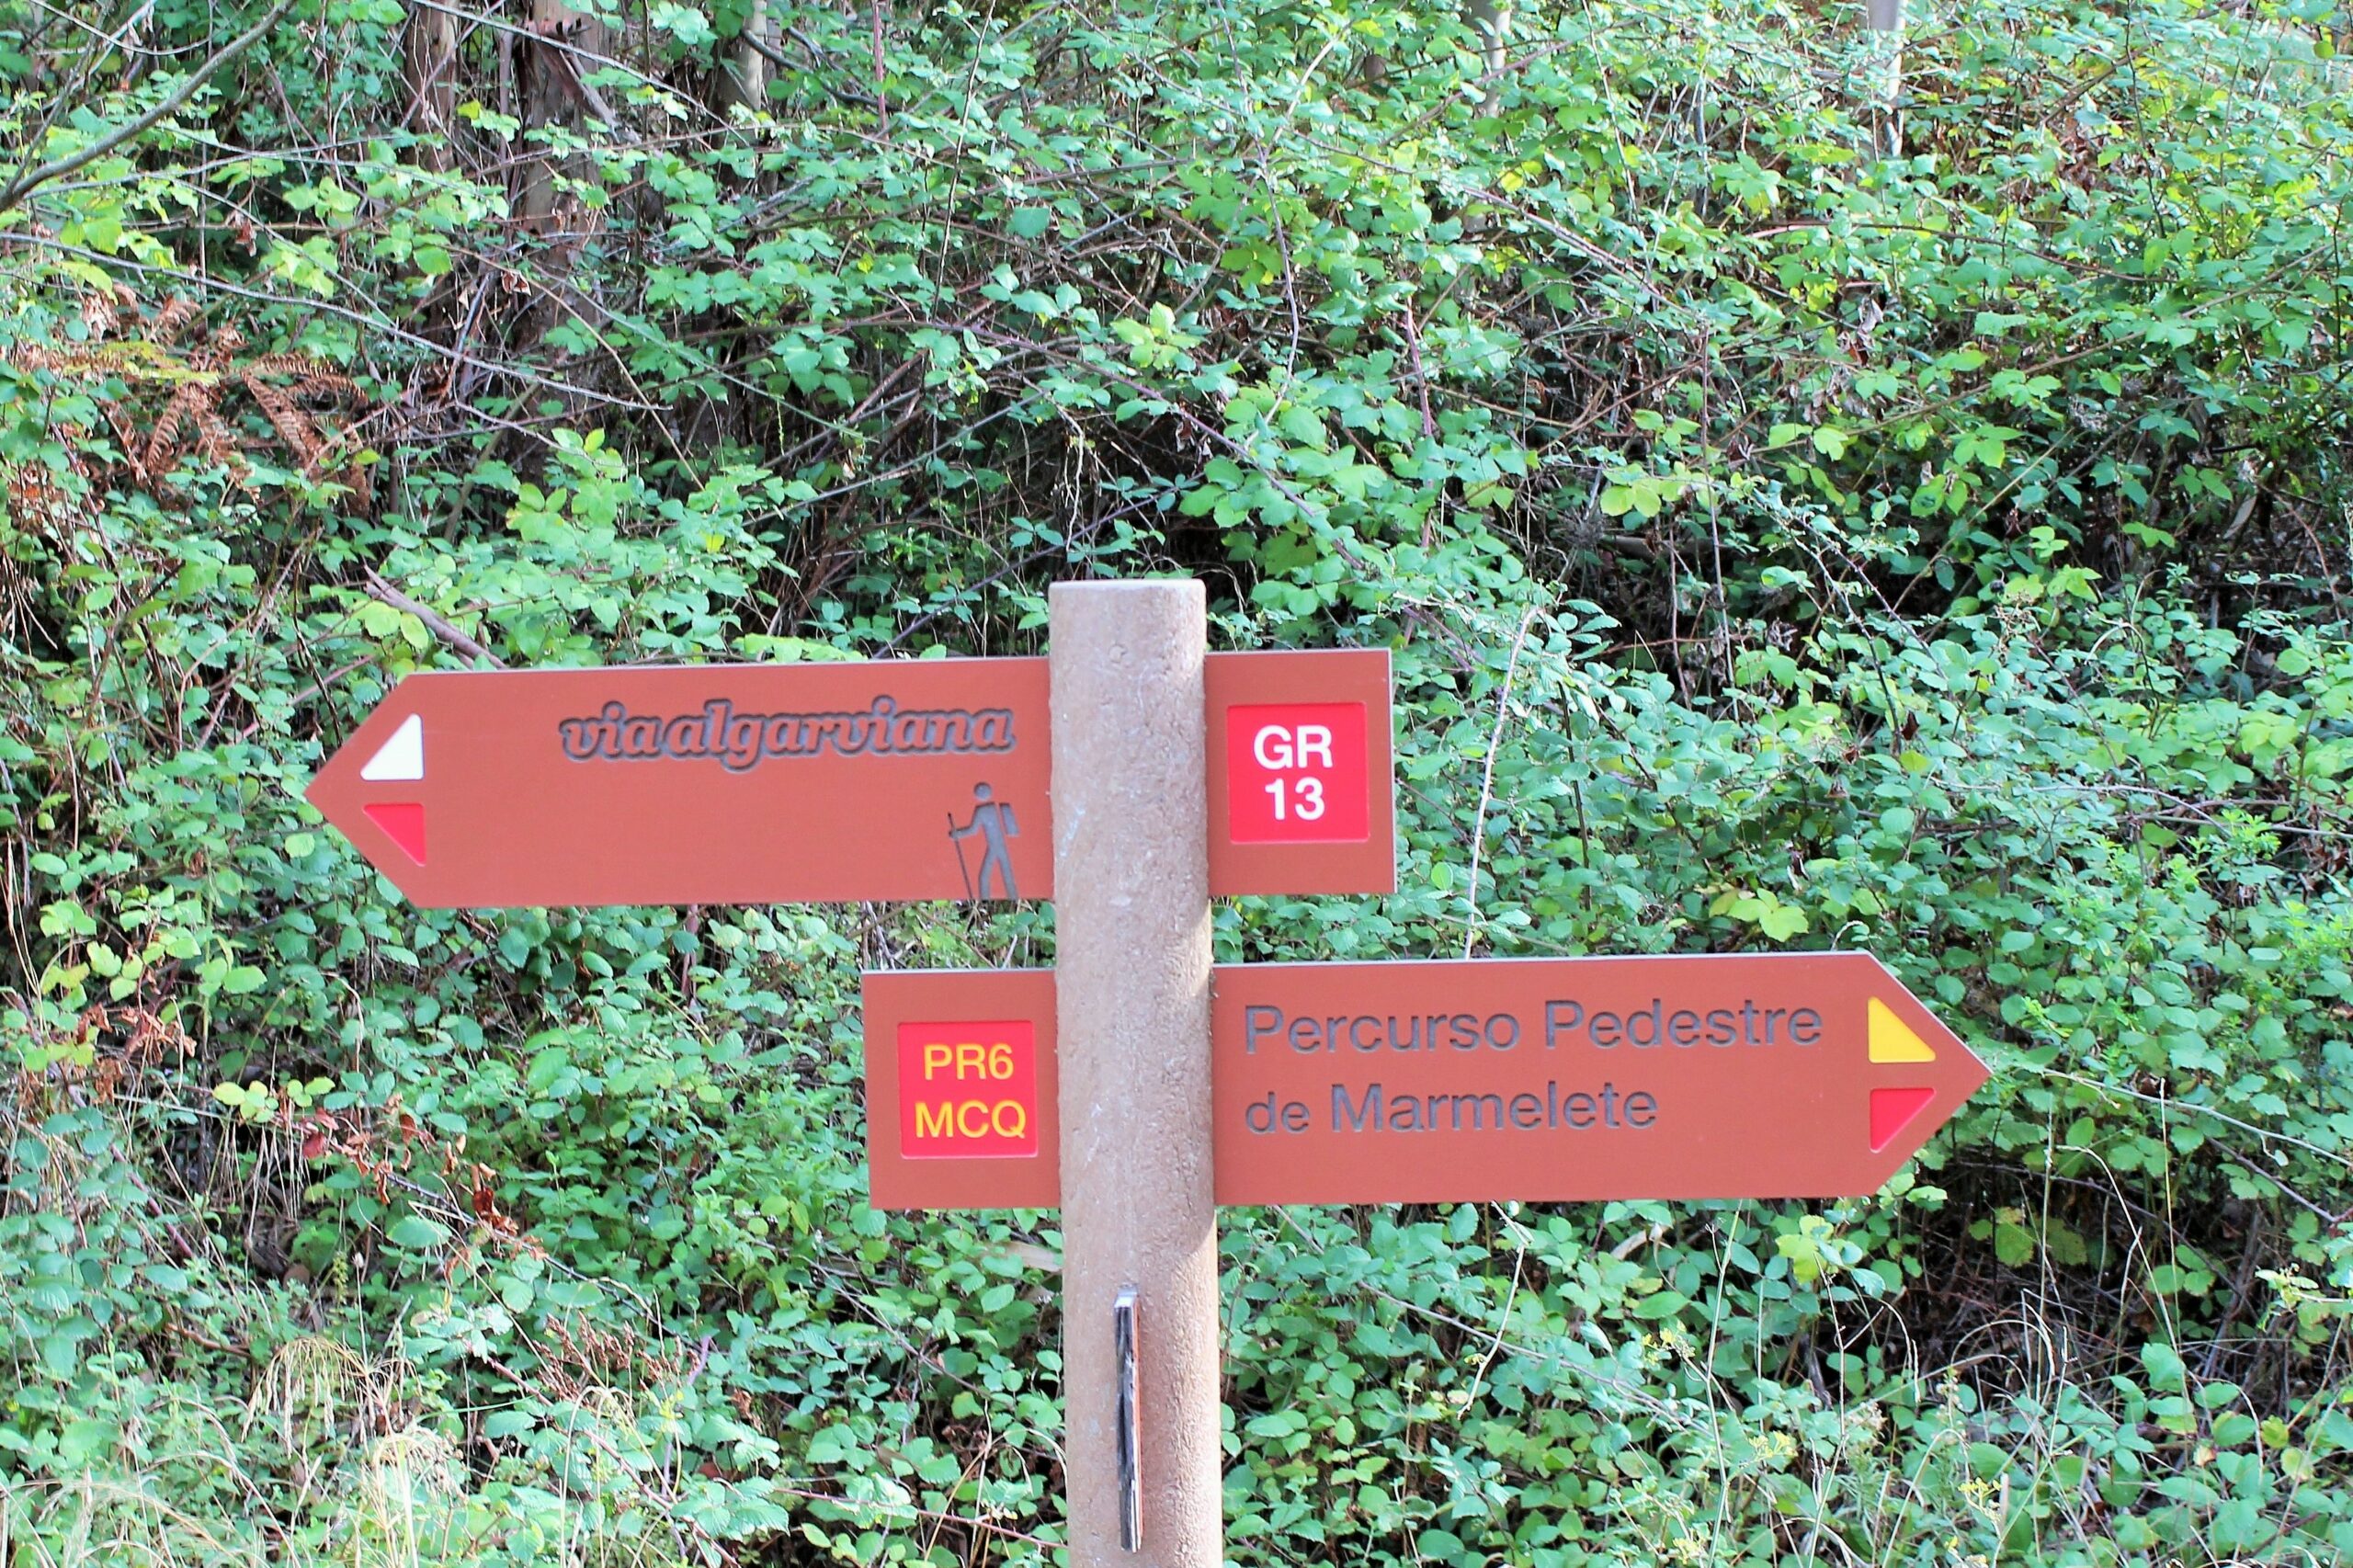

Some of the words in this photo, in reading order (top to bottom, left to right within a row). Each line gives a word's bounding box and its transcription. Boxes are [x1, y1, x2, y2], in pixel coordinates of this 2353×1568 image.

[1253, 724, 1333, 770] GR
[1265, 777, 1325, 821] 13
[1245, 1005, 1520, 1054] Percurso
[1544, 997, 1823, 1049] Pedestre
[924, 1043, 1015, 1081] PR6
[915, 1100, 1027, 1139] MCQ
[1245, 1091, 1311, 1134] de
[1331, 1080, 1658, 1133] Marmelete
